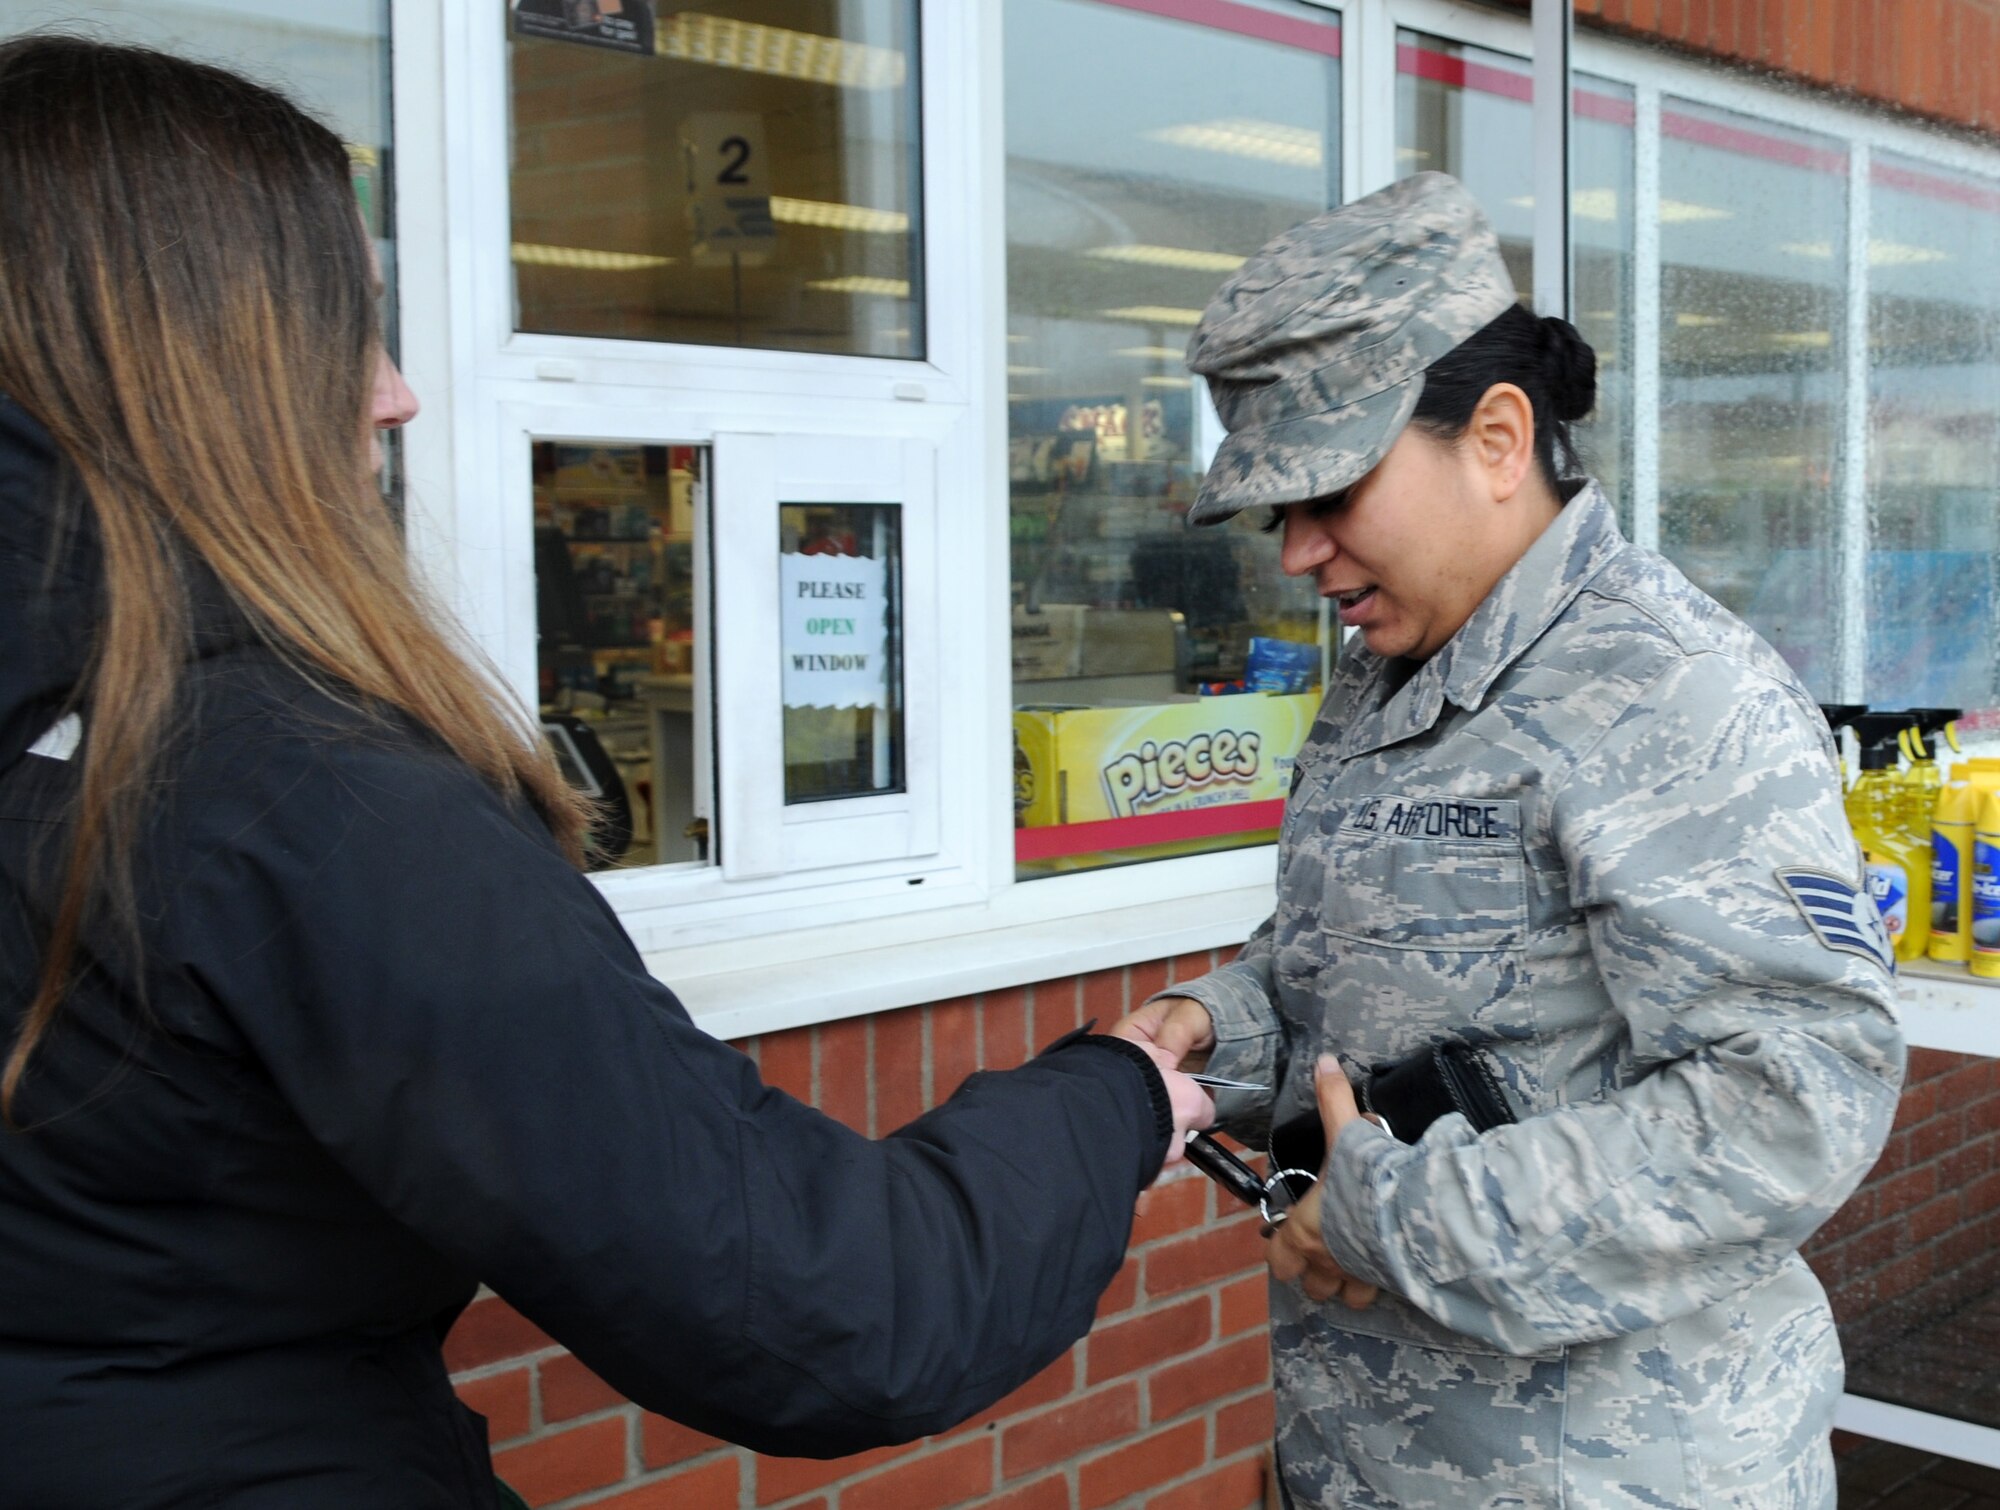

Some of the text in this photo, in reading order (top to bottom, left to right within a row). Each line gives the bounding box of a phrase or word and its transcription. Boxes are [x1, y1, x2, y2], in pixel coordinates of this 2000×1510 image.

[717, 135, 750, 184] 2
[798, 581, 866, 599] PLEASE
[806, 618, 856, 635] OPEN
[792, 654, 868, 671] WINDOW
[1103, 729, 1260, 818] pieces
